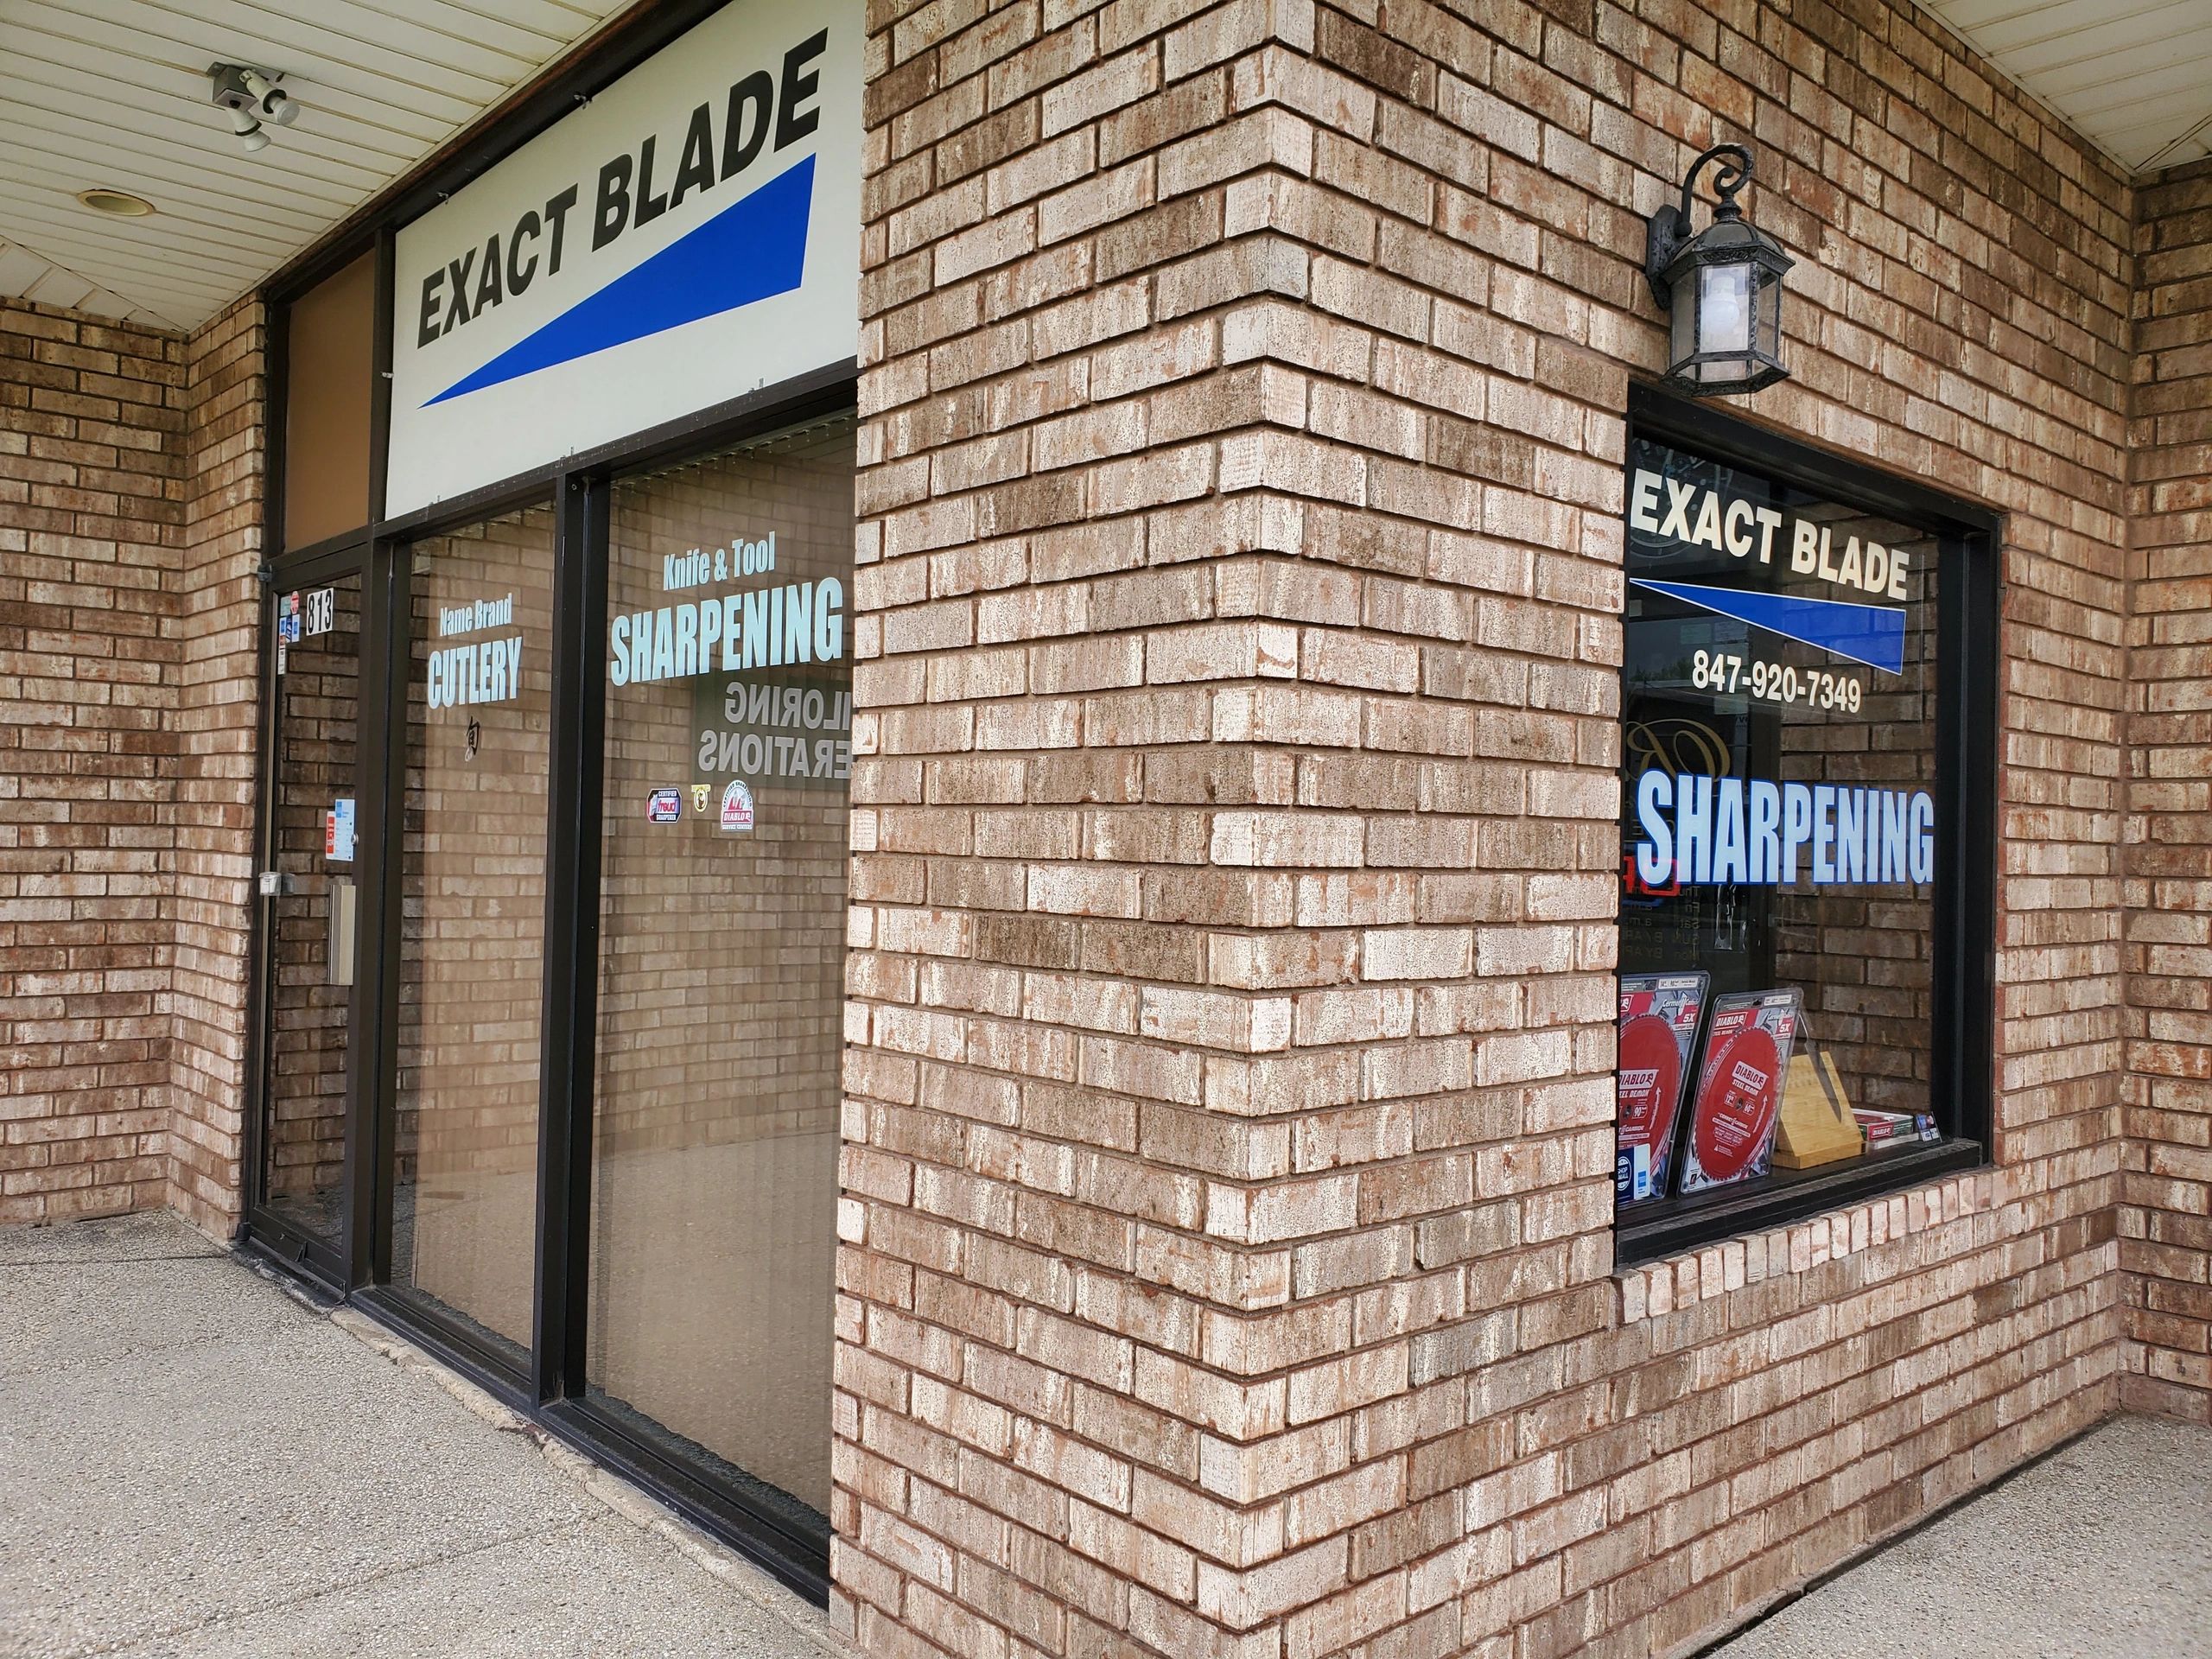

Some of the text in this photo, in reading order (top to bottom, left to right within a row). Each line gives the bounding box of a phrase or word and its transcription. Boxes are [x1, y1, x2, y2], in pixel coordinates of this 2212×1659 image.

[417, 27, 829, 349] EXACT BLADE
[1630, 467, 1910, 601] EXACT BLADE
[664, 531, 775, 590] Knife & Tool
[308, 589, 332, 633] 813
[440, 593, 512, 637] Name Brand
[611, 576, 843, 687] SHARPENING
[428, 637, 522, 709] CUTLERY
[1692, 650, 1861, 713] 847-920-7349
[658, 799, 678, 811] freud
[724, 812, 746, 822] DIABLO
[1637, 768, 1935, 886] SHARPENING
[1683, 1014, 1695, 1023] 5X
[1715, 1014, 1738, 1027] DIABLO
[1780, 1023, 1790, 1033] 5X
[1735, 1065, 1759, 1084] DIABLO
